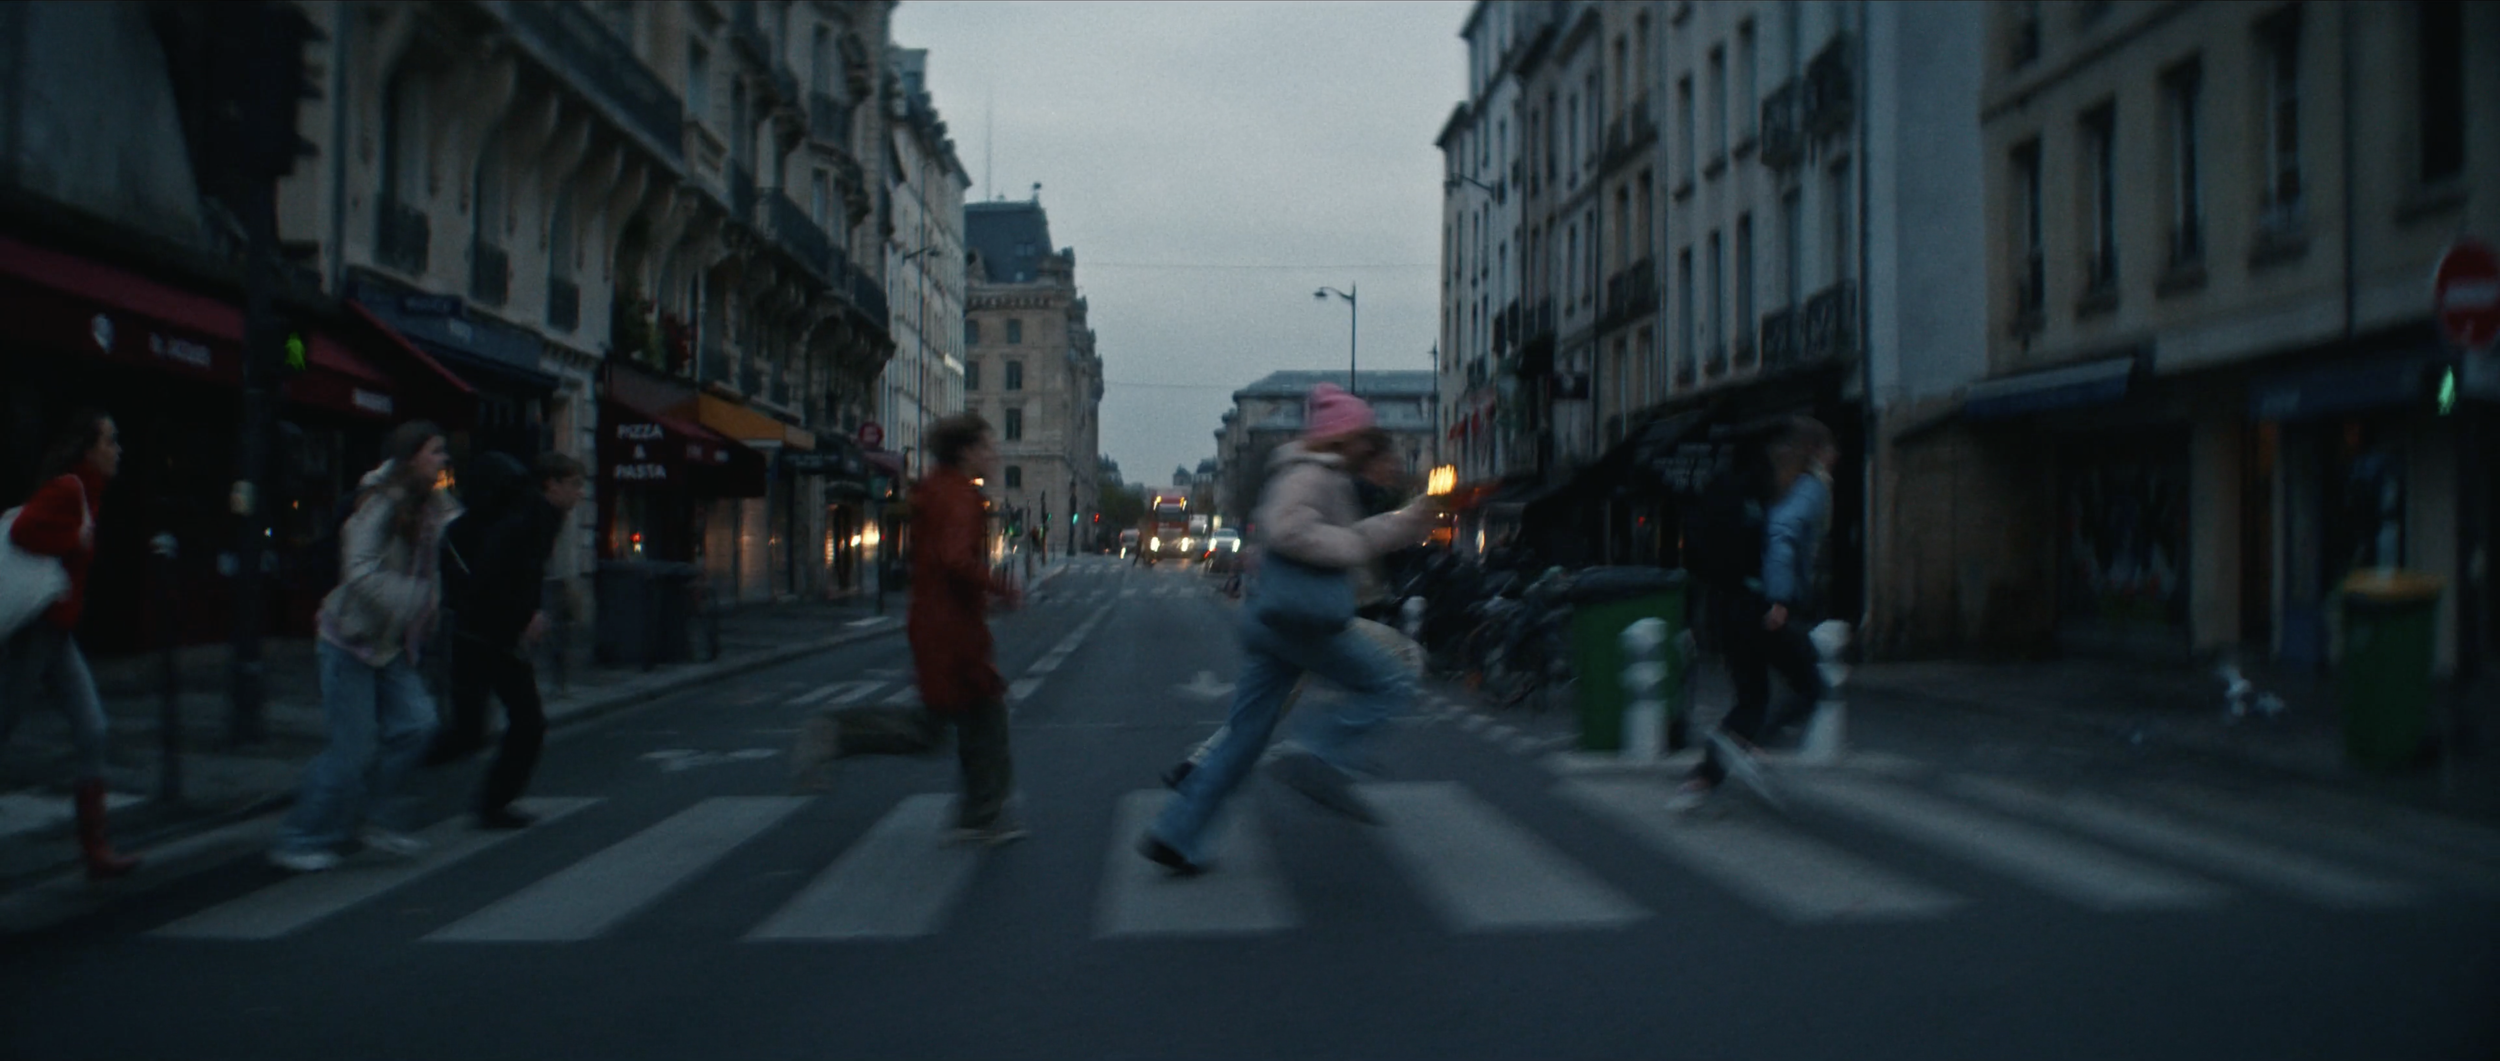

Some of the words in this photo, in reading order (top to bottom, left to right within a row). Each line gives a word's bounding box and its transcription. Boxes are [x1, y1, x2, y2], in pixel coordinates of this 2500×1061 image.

[616, 422, 664, 440] PIZZA
[633, 443, 646, 459] &
[613, 463, 667, 480] PASTA
